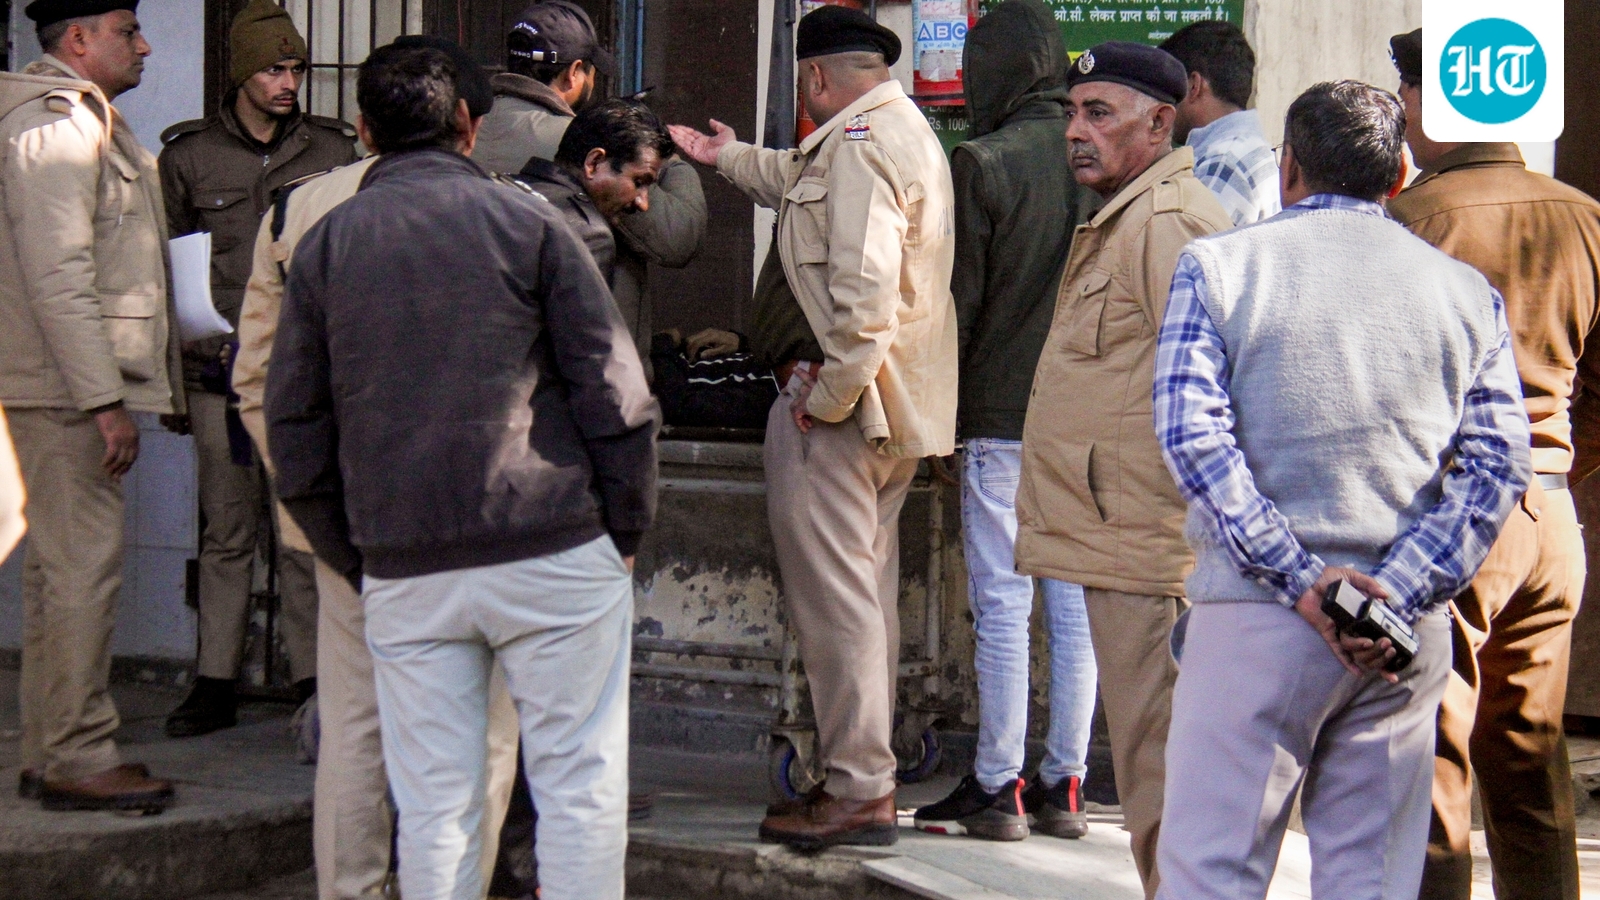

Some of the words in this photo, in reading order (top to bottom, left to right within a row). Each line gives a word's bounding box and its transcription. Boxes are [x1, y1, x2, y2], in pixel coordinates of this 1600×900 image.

[1089, 5, 1117, 22] लेकर
[1119, 9, 1142, 22] प्राप्त
[1145, 5, 1161, 22] की
[1163, 9, 1178, 22] जा
[1180, 5, 1213, 22] सकती
[918, 24, 966, 40] ABC
[928, 117, 943, 130] Rs.
[948, 117, 970, 131] 100/-
